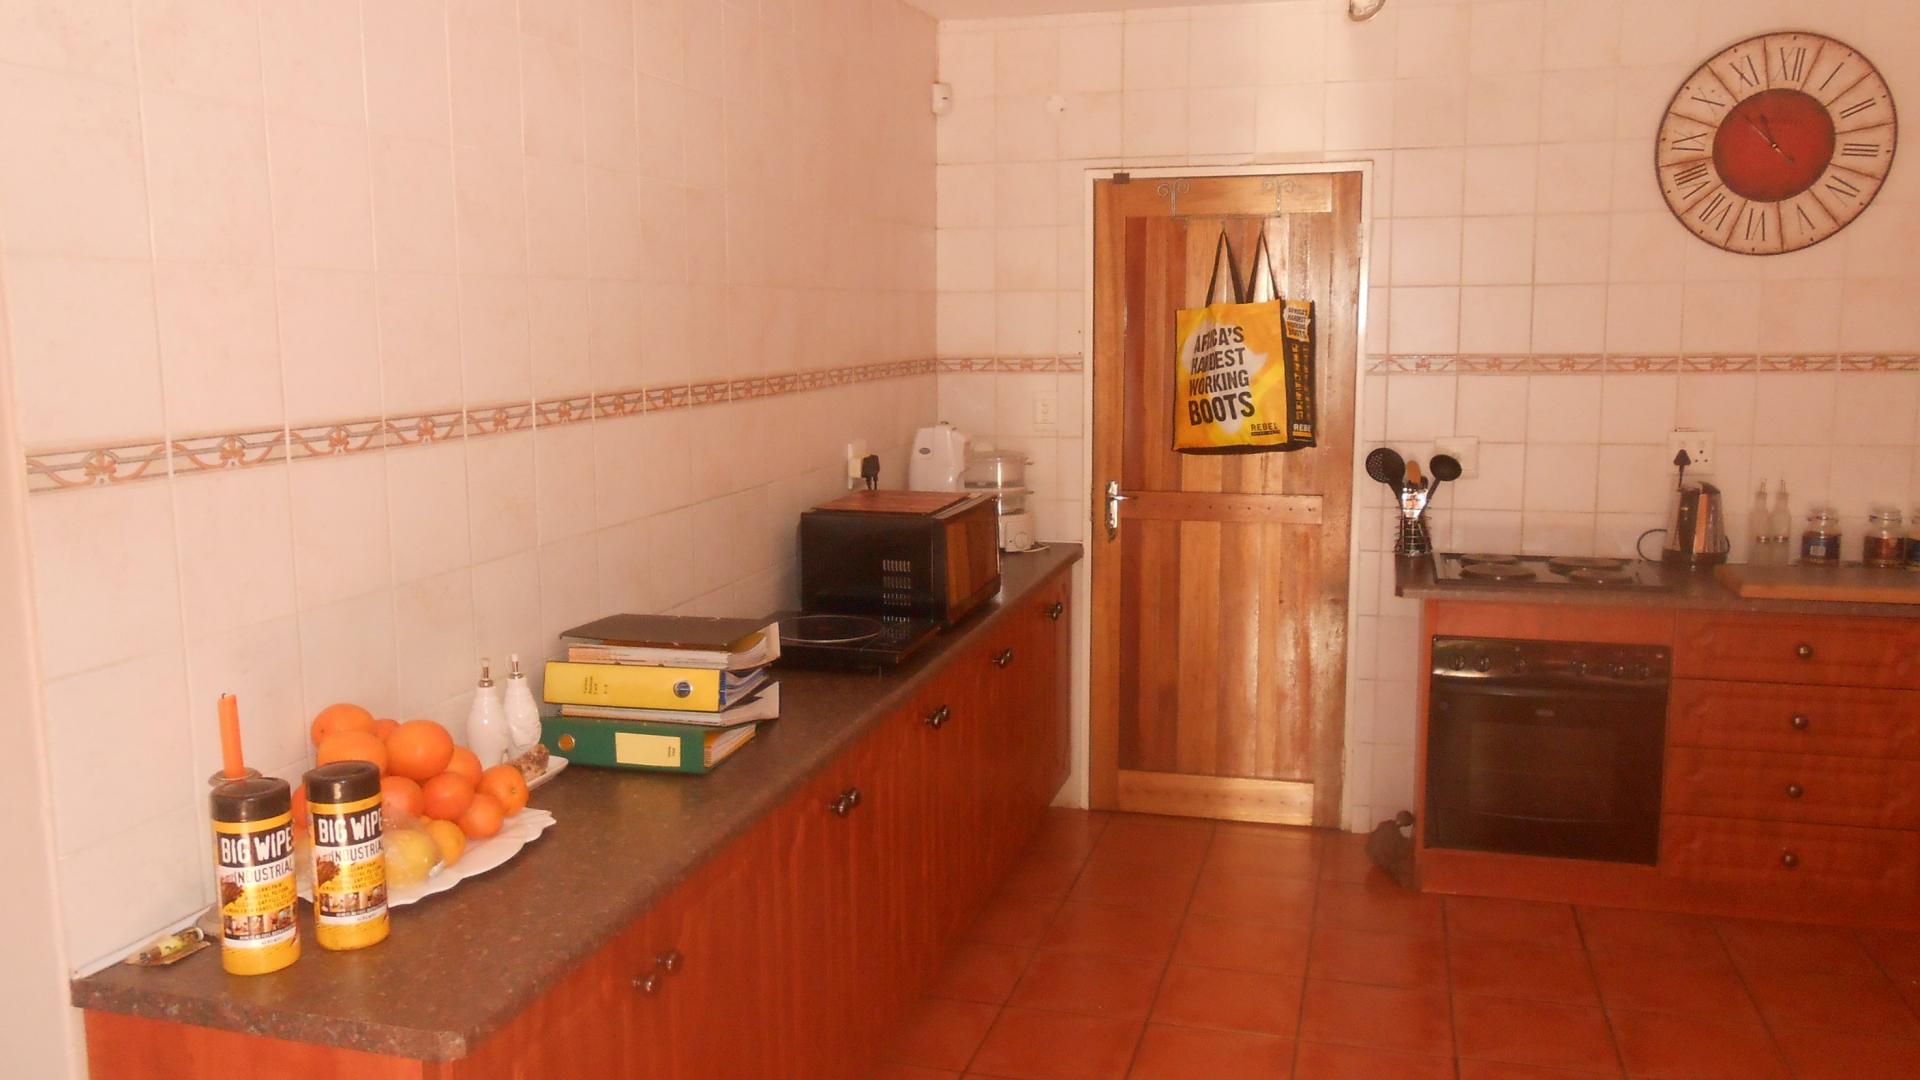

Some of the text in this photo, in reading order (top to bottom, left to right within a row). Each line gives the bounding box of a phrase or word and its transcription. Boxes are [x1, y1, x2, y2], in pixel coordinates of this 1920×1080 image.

[1728, 55, 1760, 92] XI
[1774, 46, 1807, 83] XII
[1839, 97, 1877, 120] II
[1841, 143, 1880, 158] III
[1189, 369, 1250, 397] WORKING
[1188, 391, 1256, 426] BOOTS
[1251, 422, 1278, 431] REBEL
[318, 817, 347, 844] BIG
[221, 836, 252, 864] BIG
[234, 859, 293, 883] INDUSTRIAL
